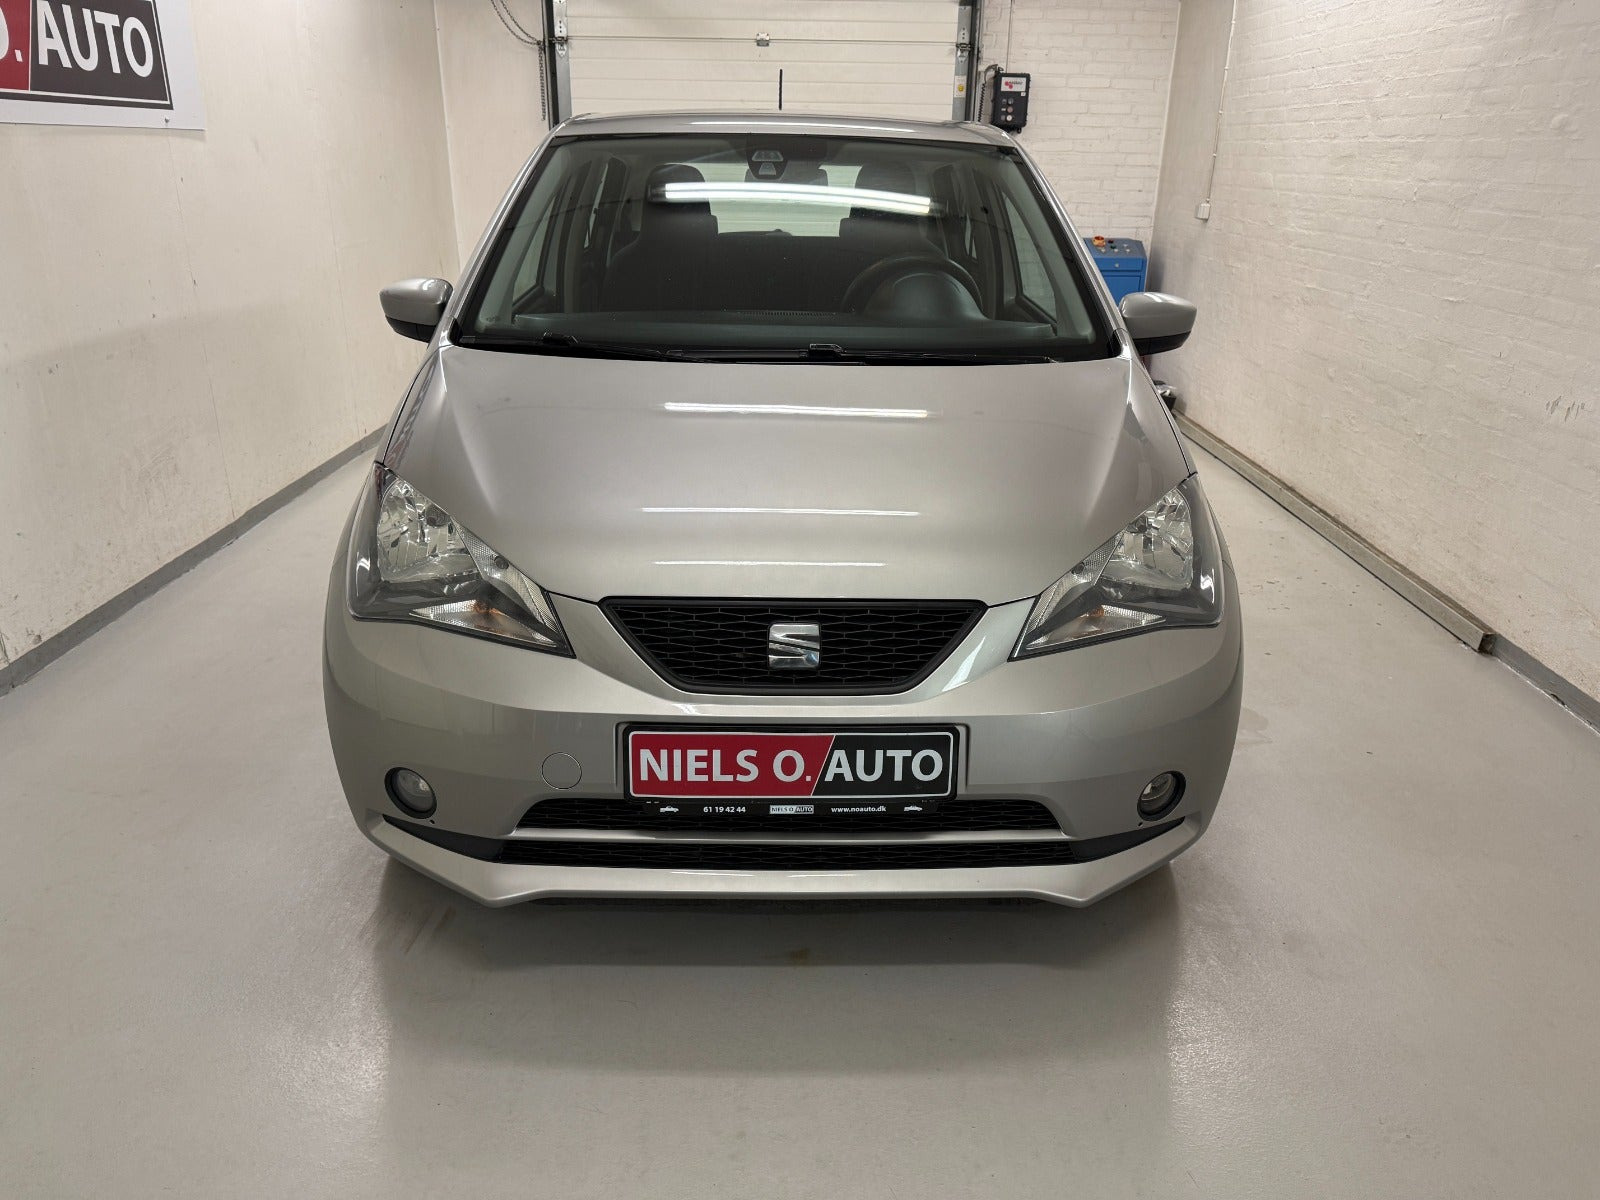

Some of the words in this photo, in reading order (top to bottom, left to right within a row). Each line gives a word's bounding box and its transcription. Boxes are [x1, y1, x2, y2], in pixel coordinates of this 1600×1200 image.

[37, 0, 153, 78] AUTO
[639, 748, 759, 782] NIELS
[772, 748, 812, 782] O.
[824, 749, 943, 782] AUTO
[831, 805, 887, 813] www.noauto.dk
